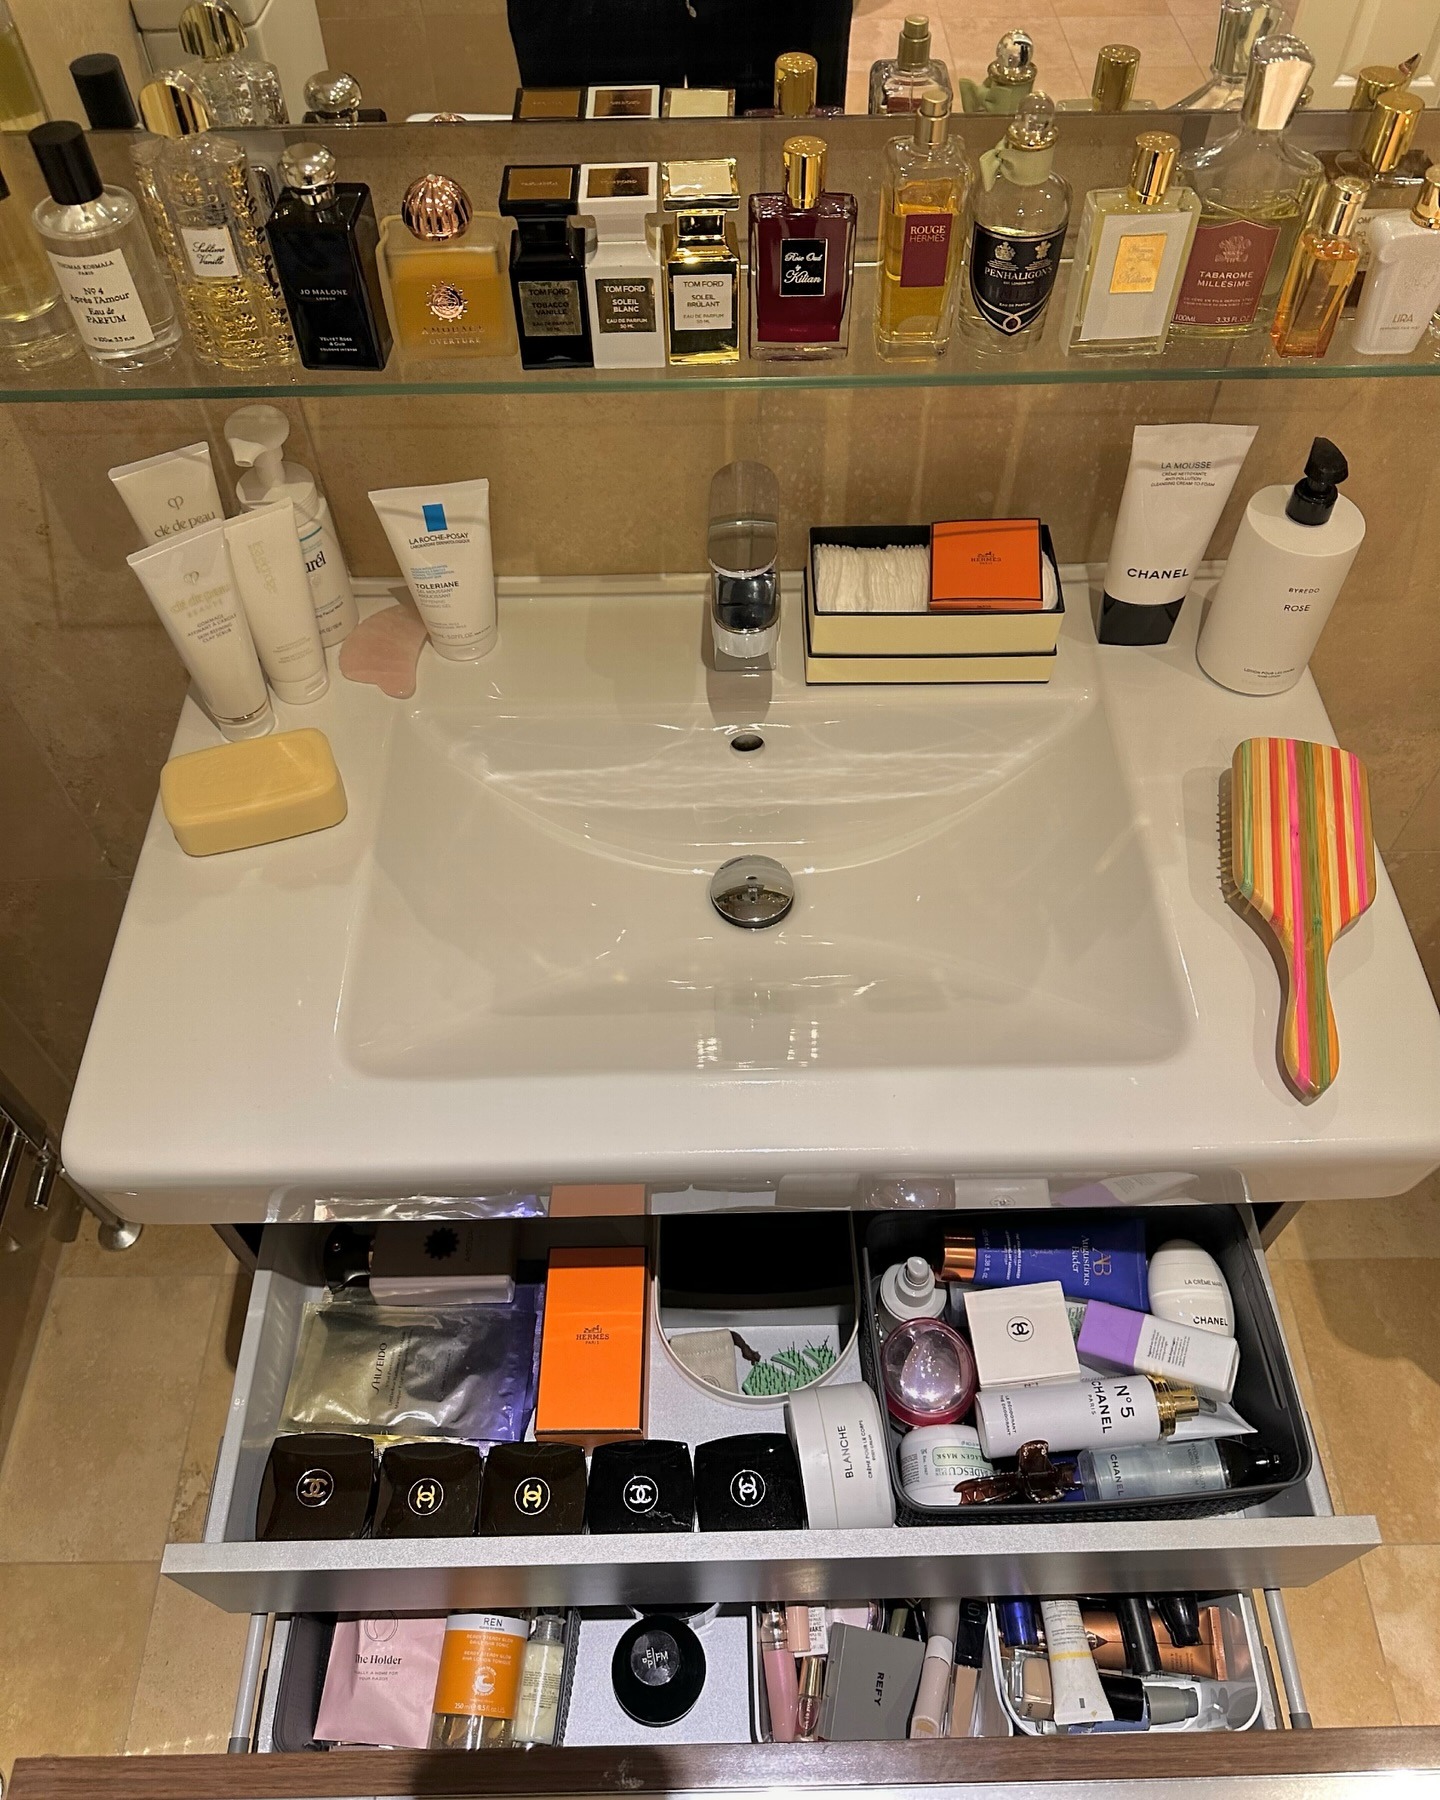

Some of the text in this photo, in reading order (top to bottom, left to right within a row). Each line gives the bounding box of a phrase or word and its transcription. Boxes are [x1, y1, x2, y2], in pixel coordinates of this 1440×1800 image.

[910, 225, 946, 235] ROUGE
[192, 242, 226, 253] Sublime
[197, 254, 225, 265] Vanille
[784, 252, 824, 262] Rose Oud
[83, 260, 114, 270] KOSMALA
[784, 270, 822, 284] Kilian
[1200, 271, 1254, 279] TABAROME
[623, 285, 646, 293] FORD
[702, 280, 724, 288] FORD
[548, 288, 570, 296] FORD
[94, 292, 130, 304] l'Amour
[612, 298, 640, 306] SOLEIL
[106, 307, 115, 315] de
[86, 314, 127, 325] PARFUM
[1216, 316, 1231, 324] 3.33
[1392, 314, 1413, 323] LIRA
[430, 337, 481, 345] OVERTURE
[1173, 461, 1212, 470] MOUSSE
[154, 511, 216, 538] clé de peau
[419, 532, 468, 543] ROCHE-POSAY
[1127, 568, 1189, 579] CHANEL
[415, 581, 460, 590] TOLERIANE
[1284, 604, 1312, 612] ROSE
[1072, 1246, 1081, 1274] Bader
[1081, 1235, 1091, 1286] Augustinus
[1193, 1316, 1229, 1327] CHANEL
[371, 1342, 388, 1396] SHISEIDO
[1088, 1394, 1097, 1416] PARIS
[1091, 1380, 1113, 1434] CHANEL
[837, 1425, 854, 1479] BLANCHE
[1110, 1454, 1124, 1496] CHANEL
[484, 1618, 503, 1627] REN
[370, 1655, 403, 1665] Holder
[874, 1672, 885, 1707] REFY
